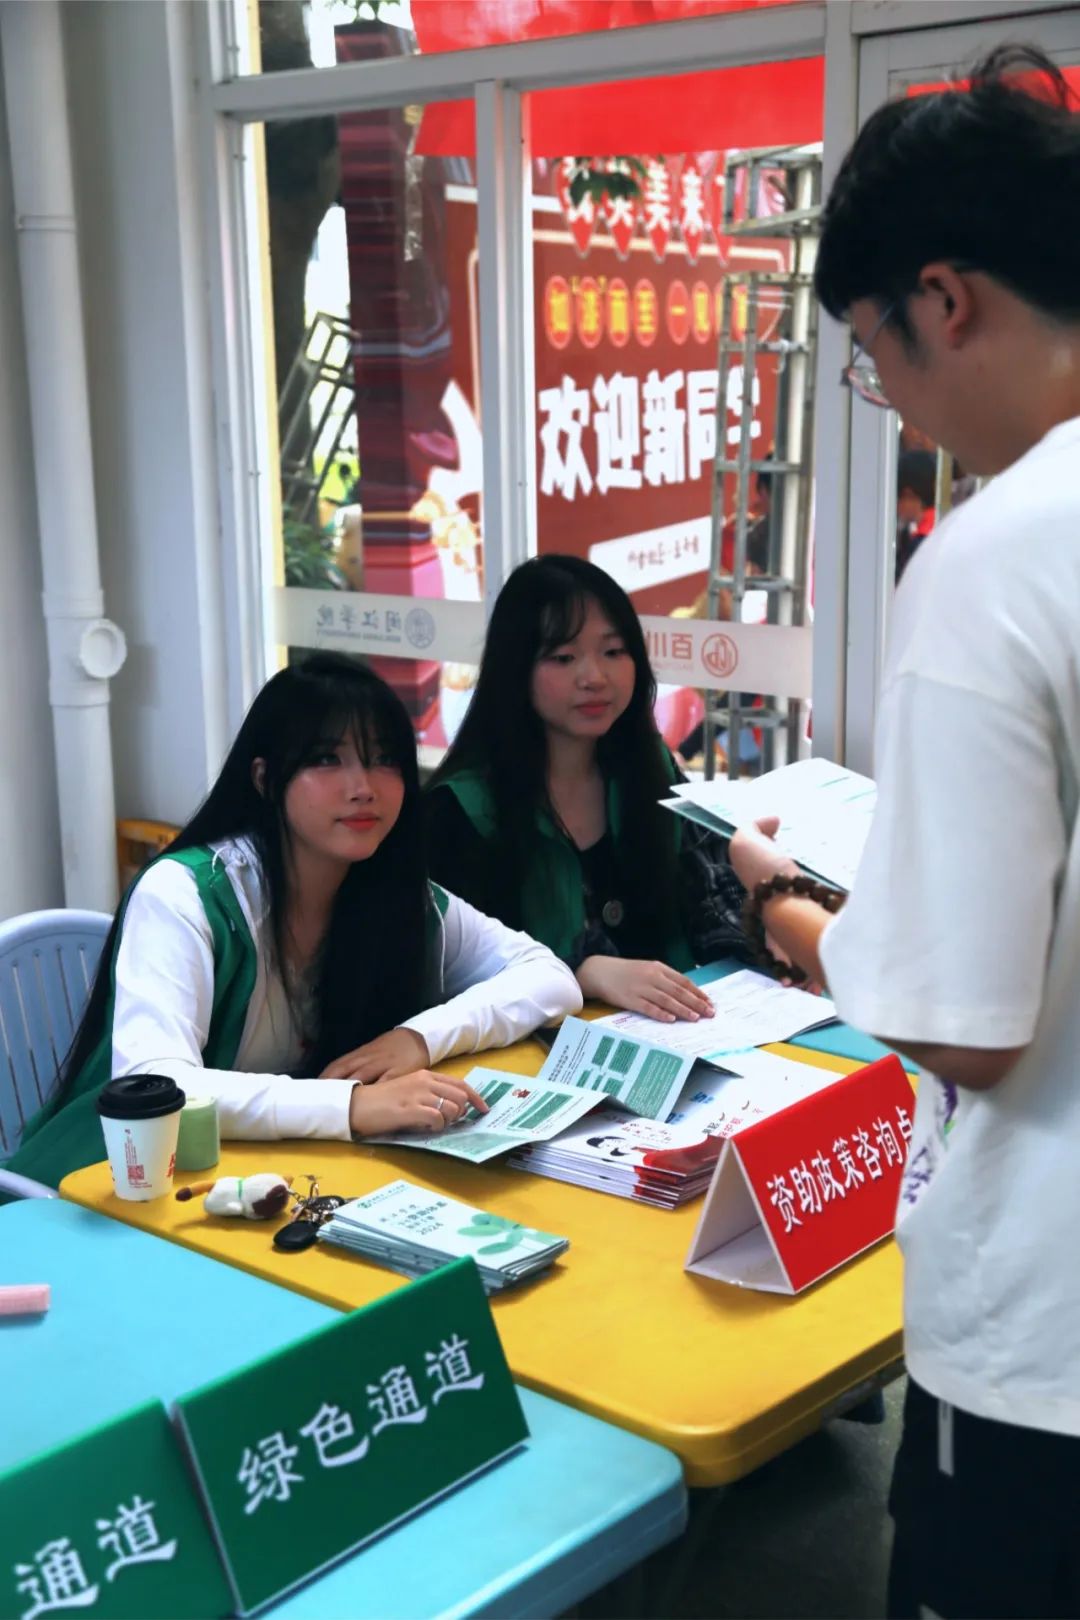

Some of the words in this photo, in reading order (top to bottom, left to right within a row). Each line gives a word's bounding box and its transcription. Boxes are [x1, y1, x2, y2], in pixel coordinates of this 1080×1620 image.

[538, 366, 761, 501] 欢迎新同学
[766, 1105, 913, 1233] 资助政策咨询点
[237, 1333, 485, 1516] 绿色通道
[14, 1494, 177, 1620] 通道
